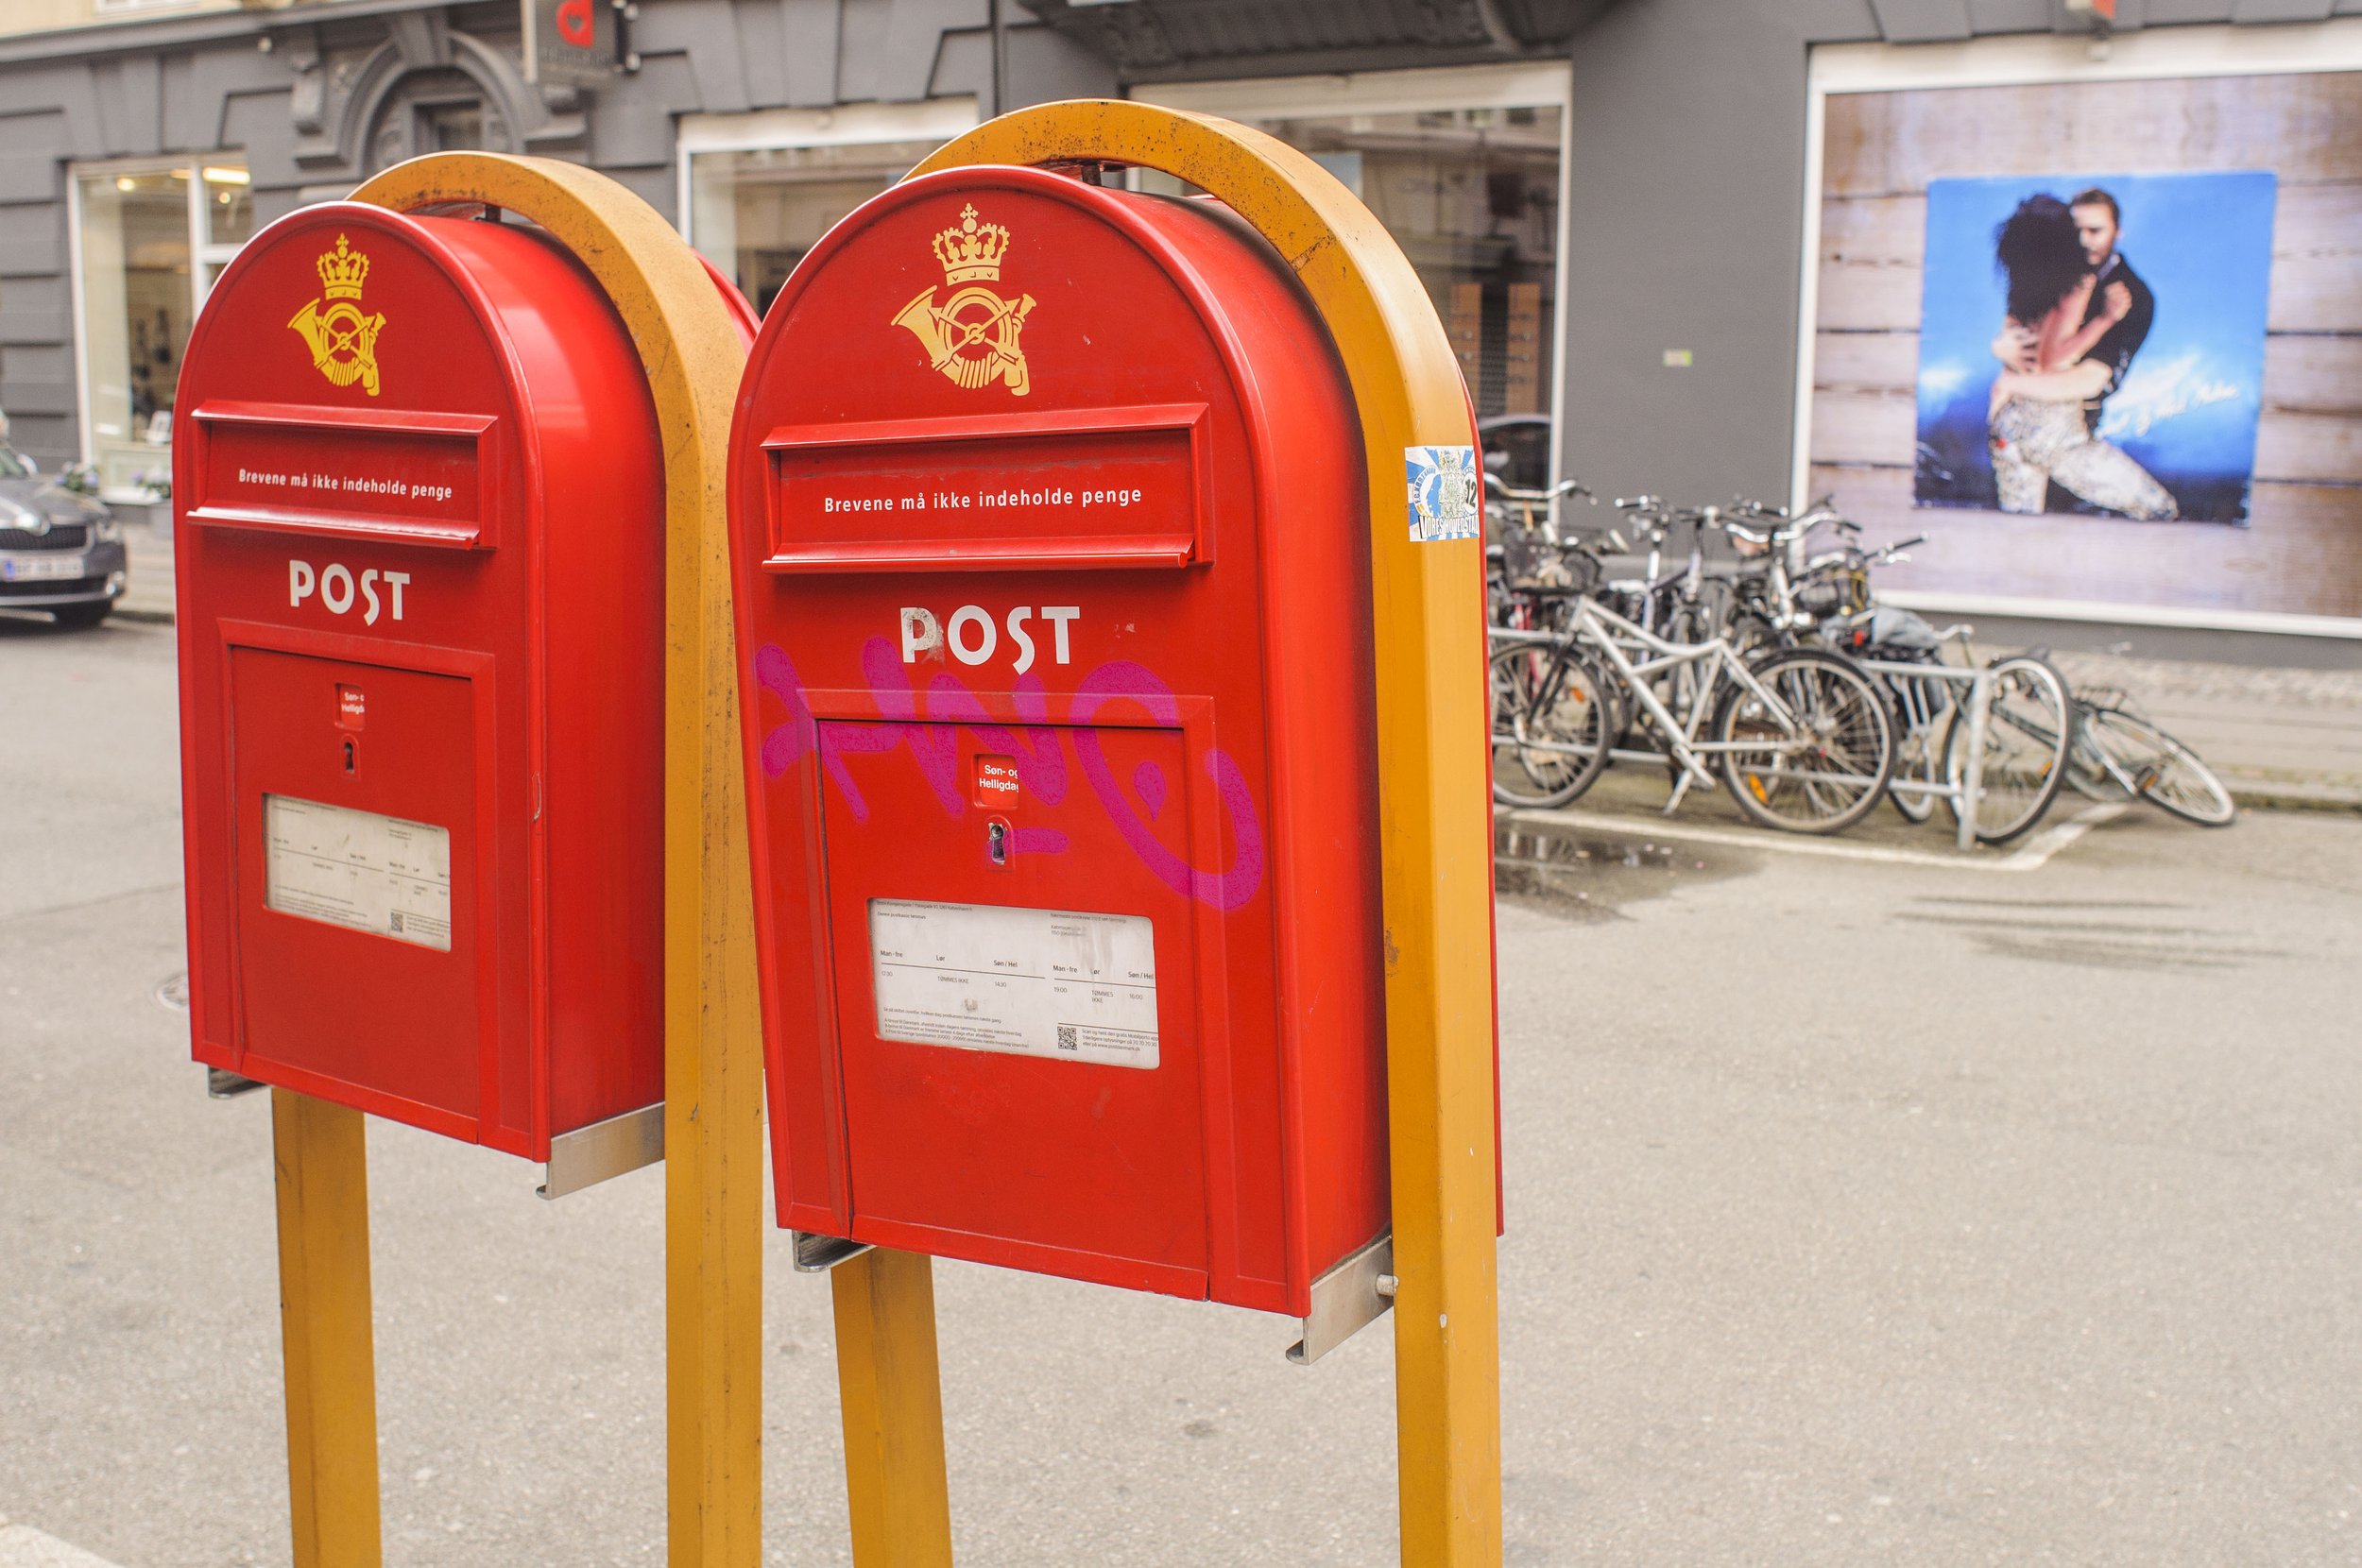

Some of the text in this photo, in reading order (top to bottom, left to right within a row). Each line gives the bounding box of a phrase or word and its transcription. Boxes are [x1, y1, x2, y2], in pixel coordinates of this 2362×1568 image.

[239, 469, 453, 502] Brevene må ikke indeholde penge
[825, 486, 1142, 513] Brevene må ikke indeholde penge
[1465, 478, 1478, 508] 12
[1418, 515, 1444, 539] VORES
[289, 559, 411, 627] POST
[899, 605, 1081, 676] POST
[984, 764, 1006, 775] Søn-
